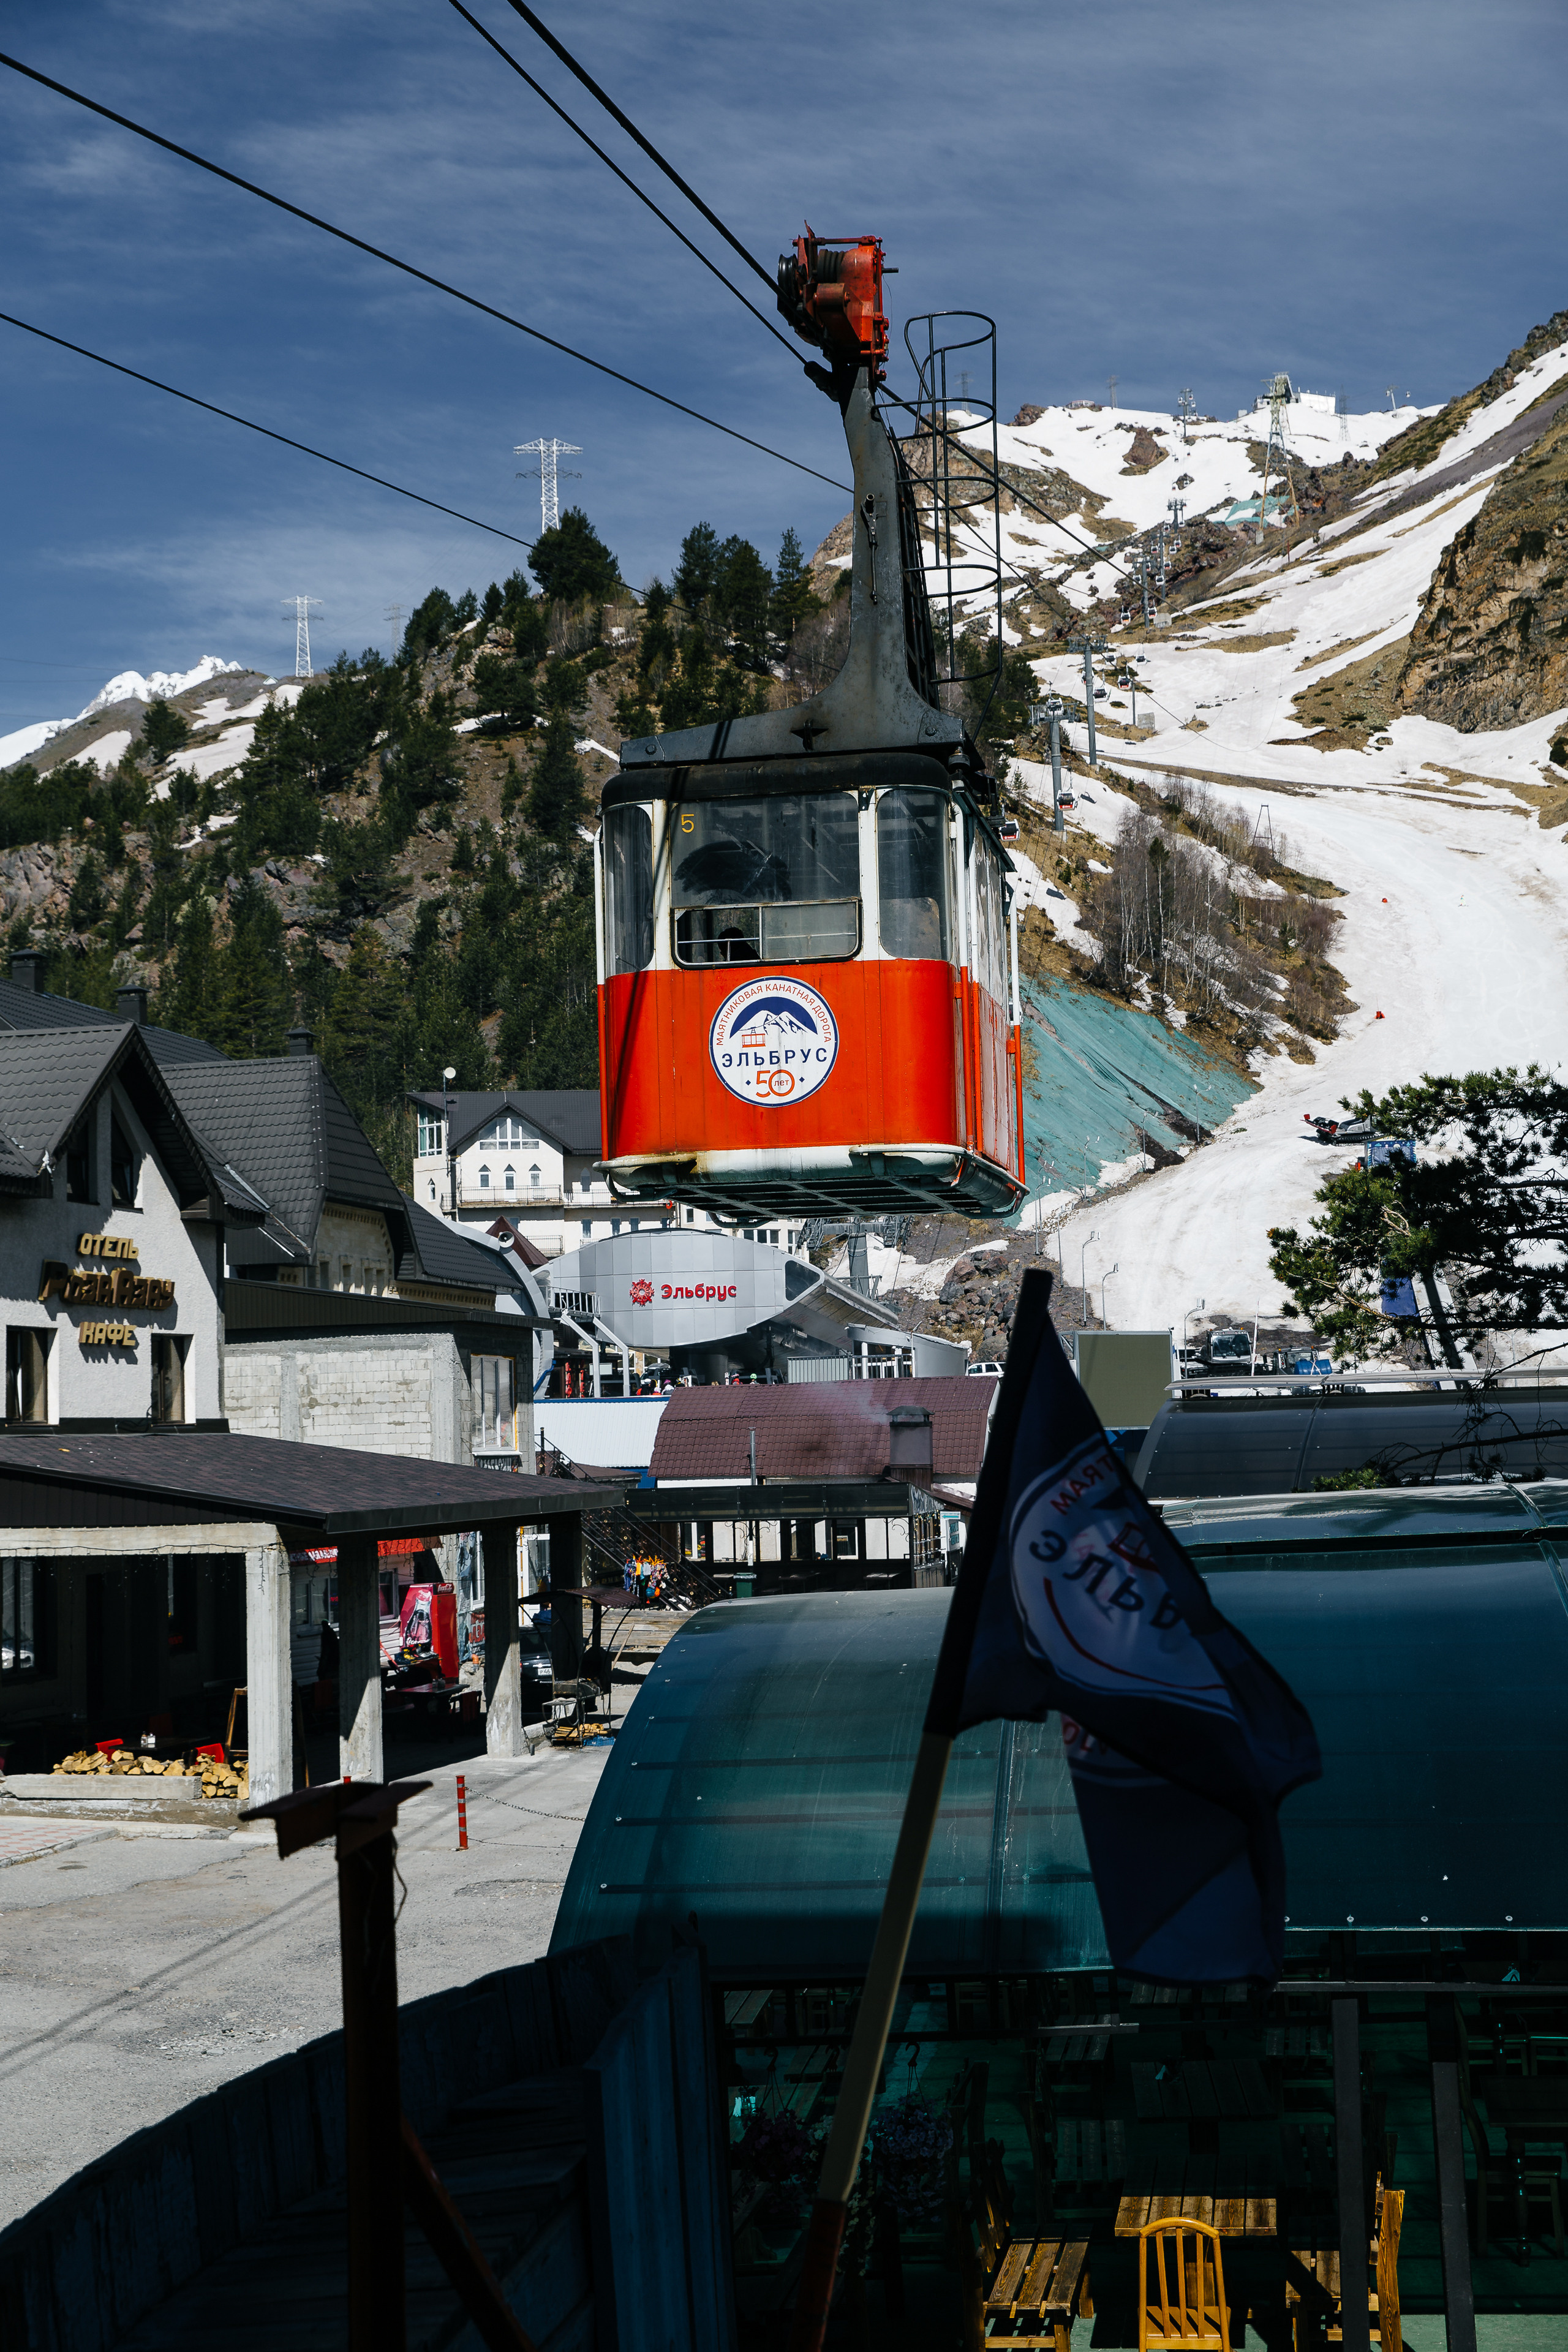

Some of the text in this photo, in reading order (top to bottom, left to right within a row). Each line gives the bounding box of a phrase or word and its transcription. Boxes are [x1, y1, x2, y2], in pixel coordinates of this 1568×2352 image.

[681, 813, 695, 833] 5
[716, 983, 832, 1046] МАЯТНИКОВАЯ КАНАТНАЯ ДОРОГА
[722, 1047, 827, 1068] ЭЛЬБРУС
[756, 1069, 795, 1098] 50
[78, 1233, 139, 1259] ОТЕЛЬ
[661, 1283, 737, 1302] Эльбрус
[79, 1322, 137, 1346] КАФЕ
